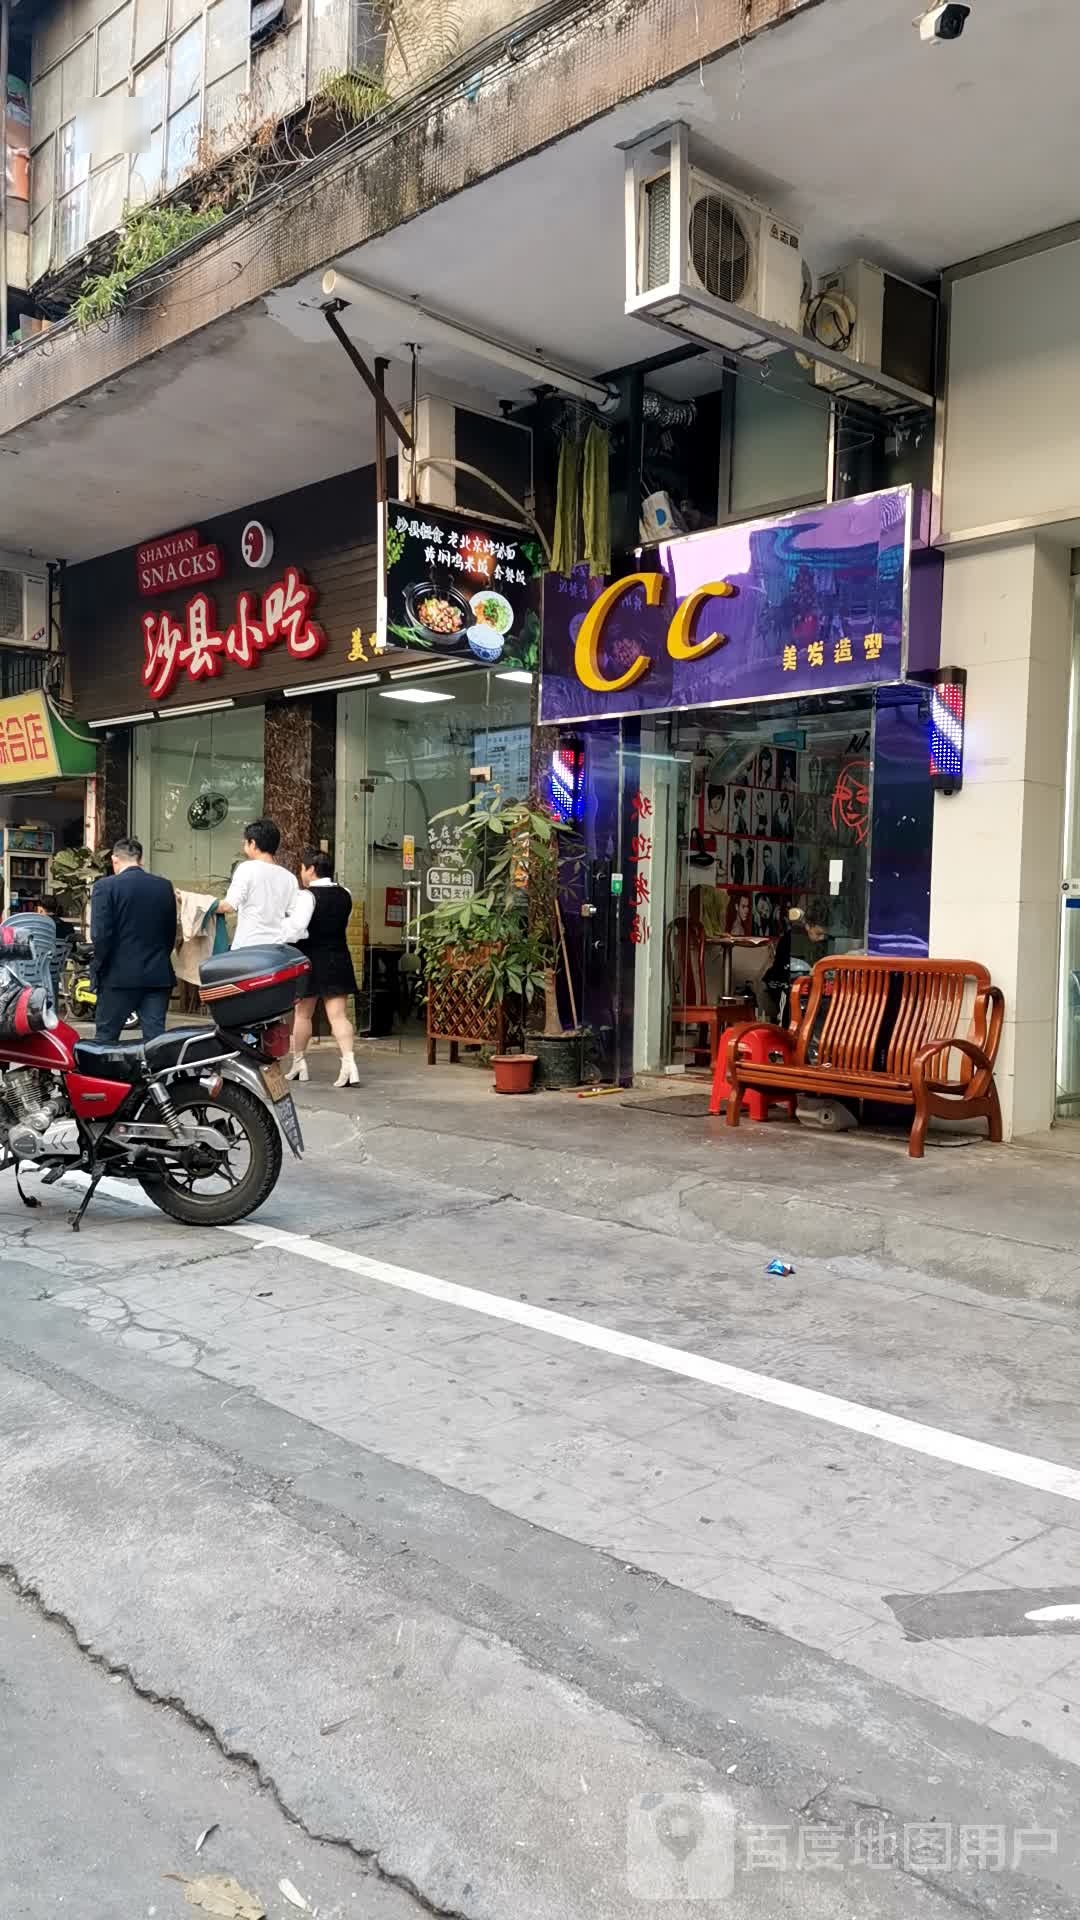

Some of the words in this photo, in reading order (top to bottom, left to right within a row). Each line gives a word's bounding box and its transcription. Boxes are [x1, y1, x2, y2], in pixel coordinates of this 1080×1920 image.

[140, 536, 195, 565] SHAXIAN
[424, 545, 489, 576] 黄焖鸡米饭
[142, 551, 217, 589] SNACKS
[142, 567, 319, 697] 沙县小吃
[783, 632, 883, 671] 美发造型
